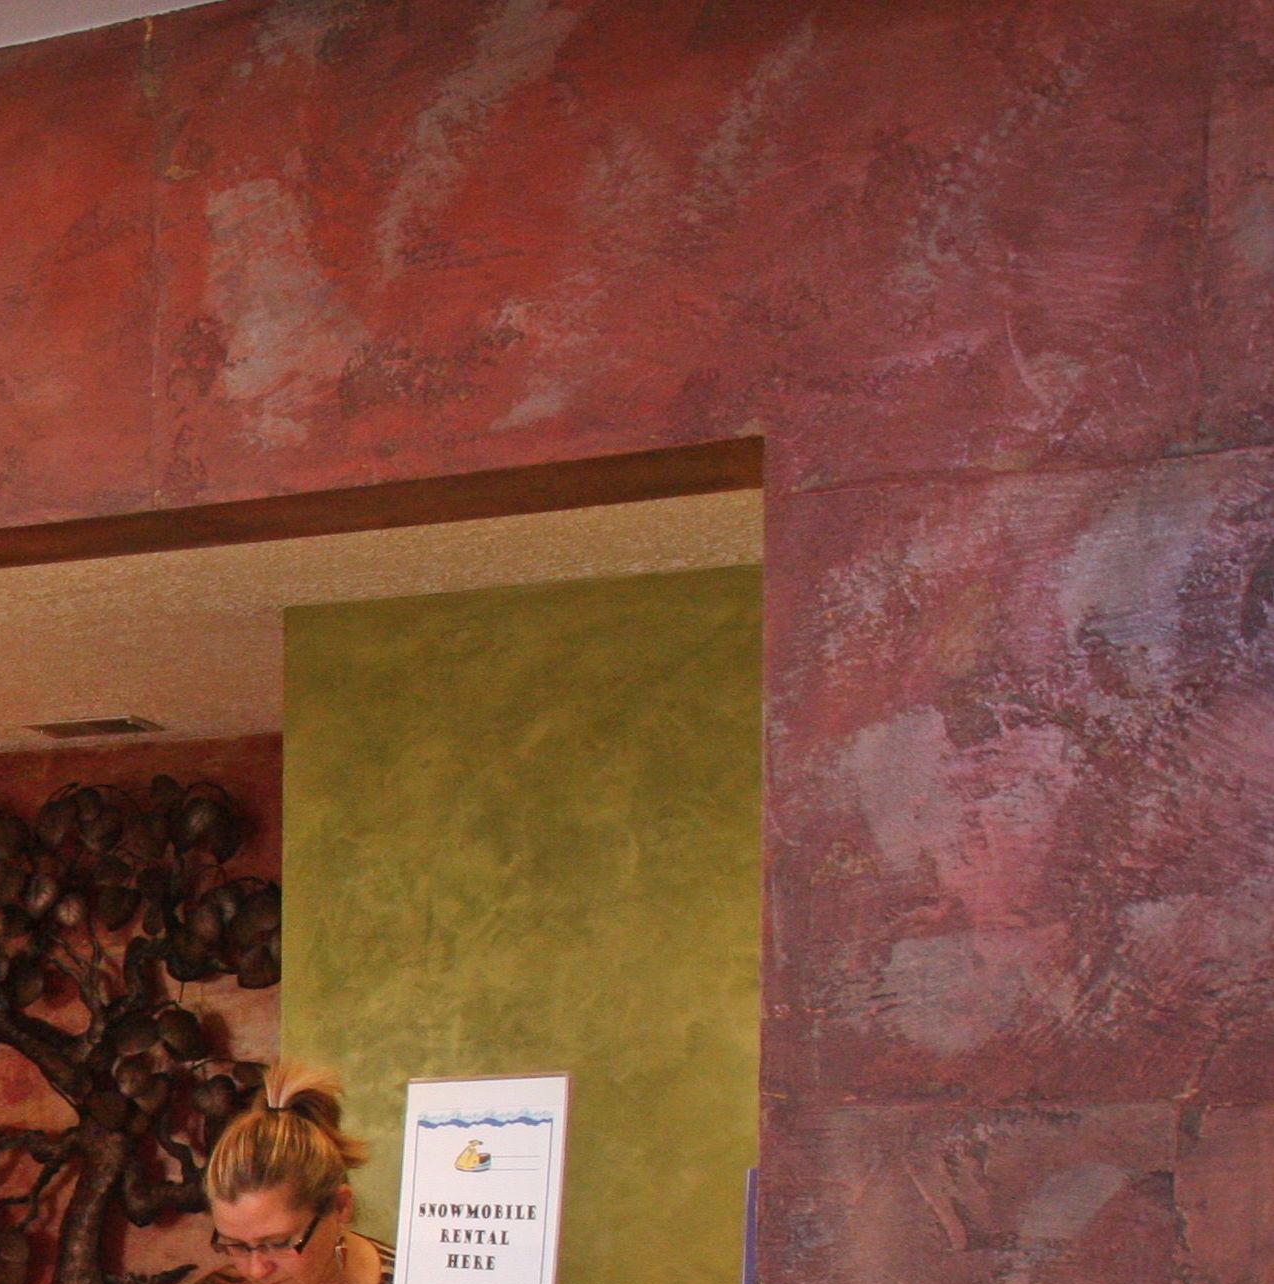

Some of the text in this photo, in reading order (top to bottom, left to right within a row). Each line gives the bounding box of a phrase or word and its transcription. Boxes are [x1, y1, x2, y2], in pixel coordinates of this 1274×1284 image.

[418, 1203, 537, 1220] SNOWMOBILE
[440, 1228, 510, 1245] RENTAL
[446, 1253, 496, 1271] HERE
